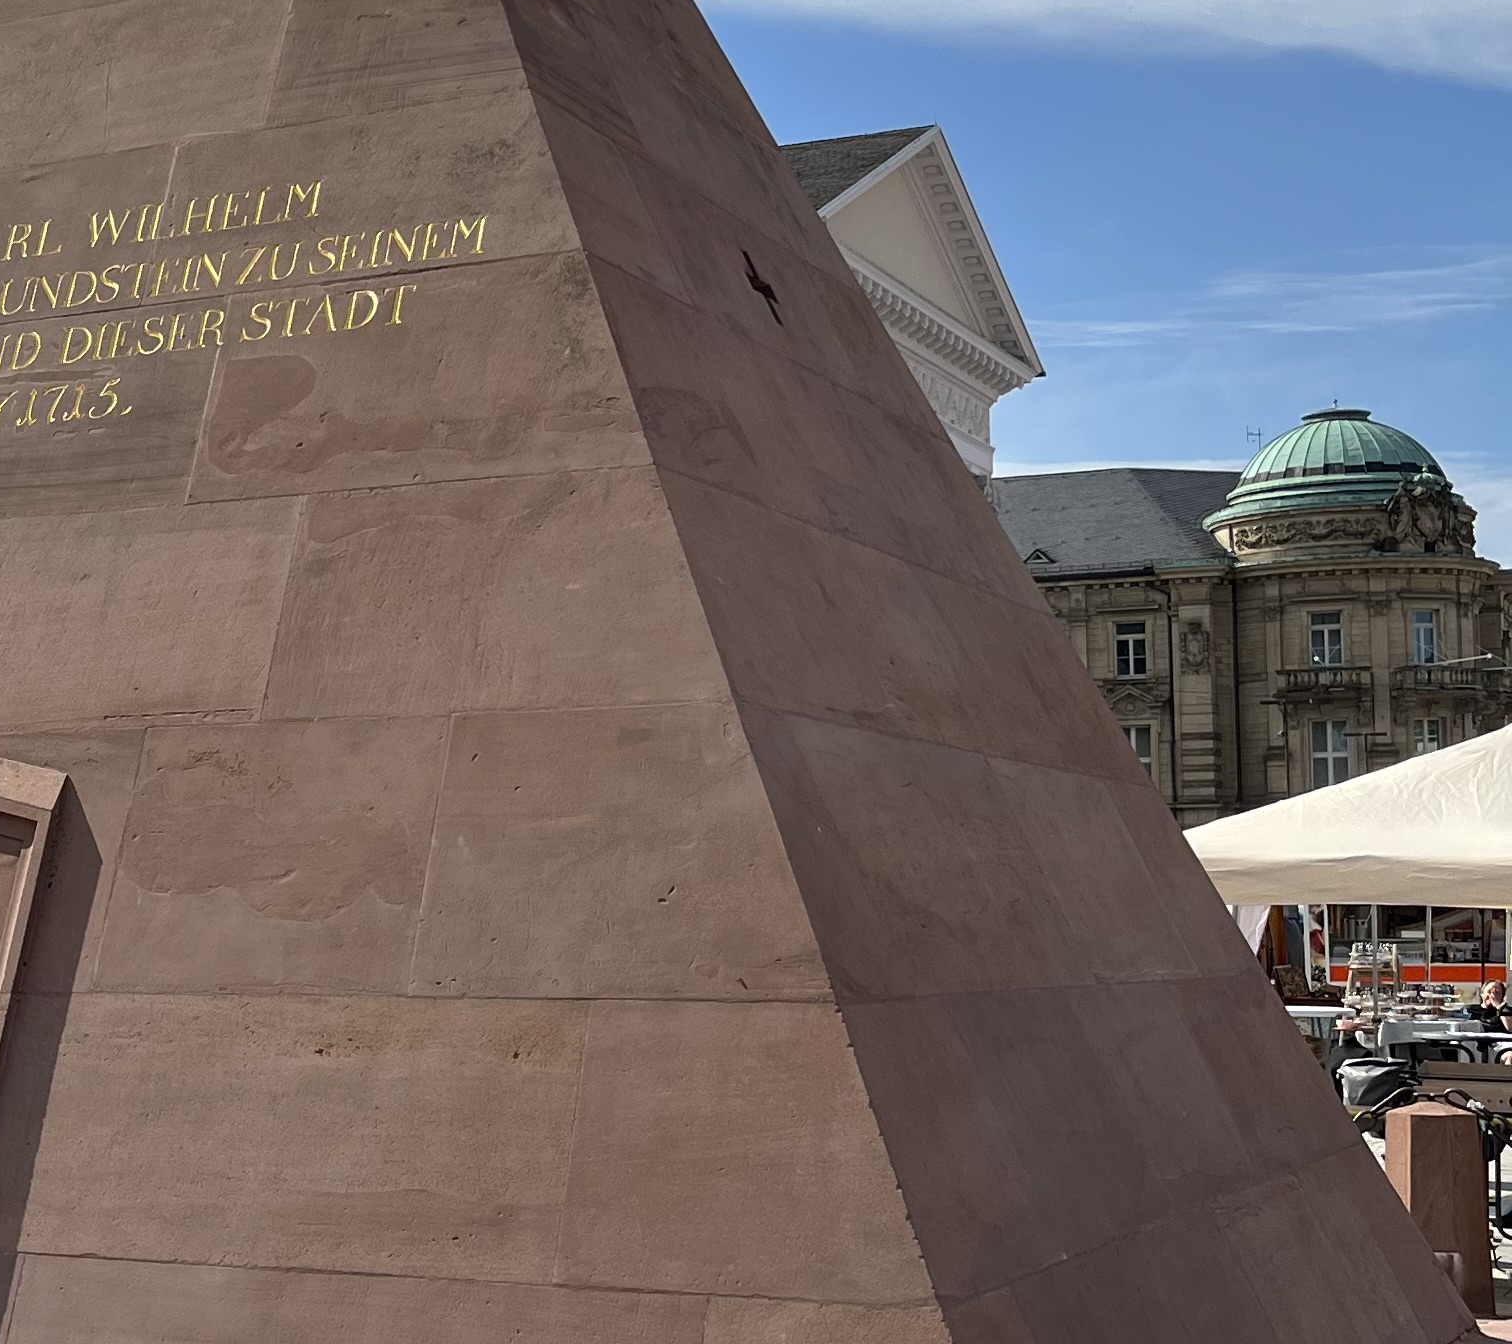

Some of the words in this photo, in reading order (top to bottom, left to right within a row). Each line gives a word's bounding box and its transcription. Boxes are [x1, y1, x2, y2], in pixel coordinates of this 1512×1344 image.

[88, 179, 325, 249] WILHELM
[234, 240, 302, 285] ZU
[307, 215, 489, 277] SEINEM
[57, 308, 225, 364] DIESER
[240, 284, 418, 342] STADT
